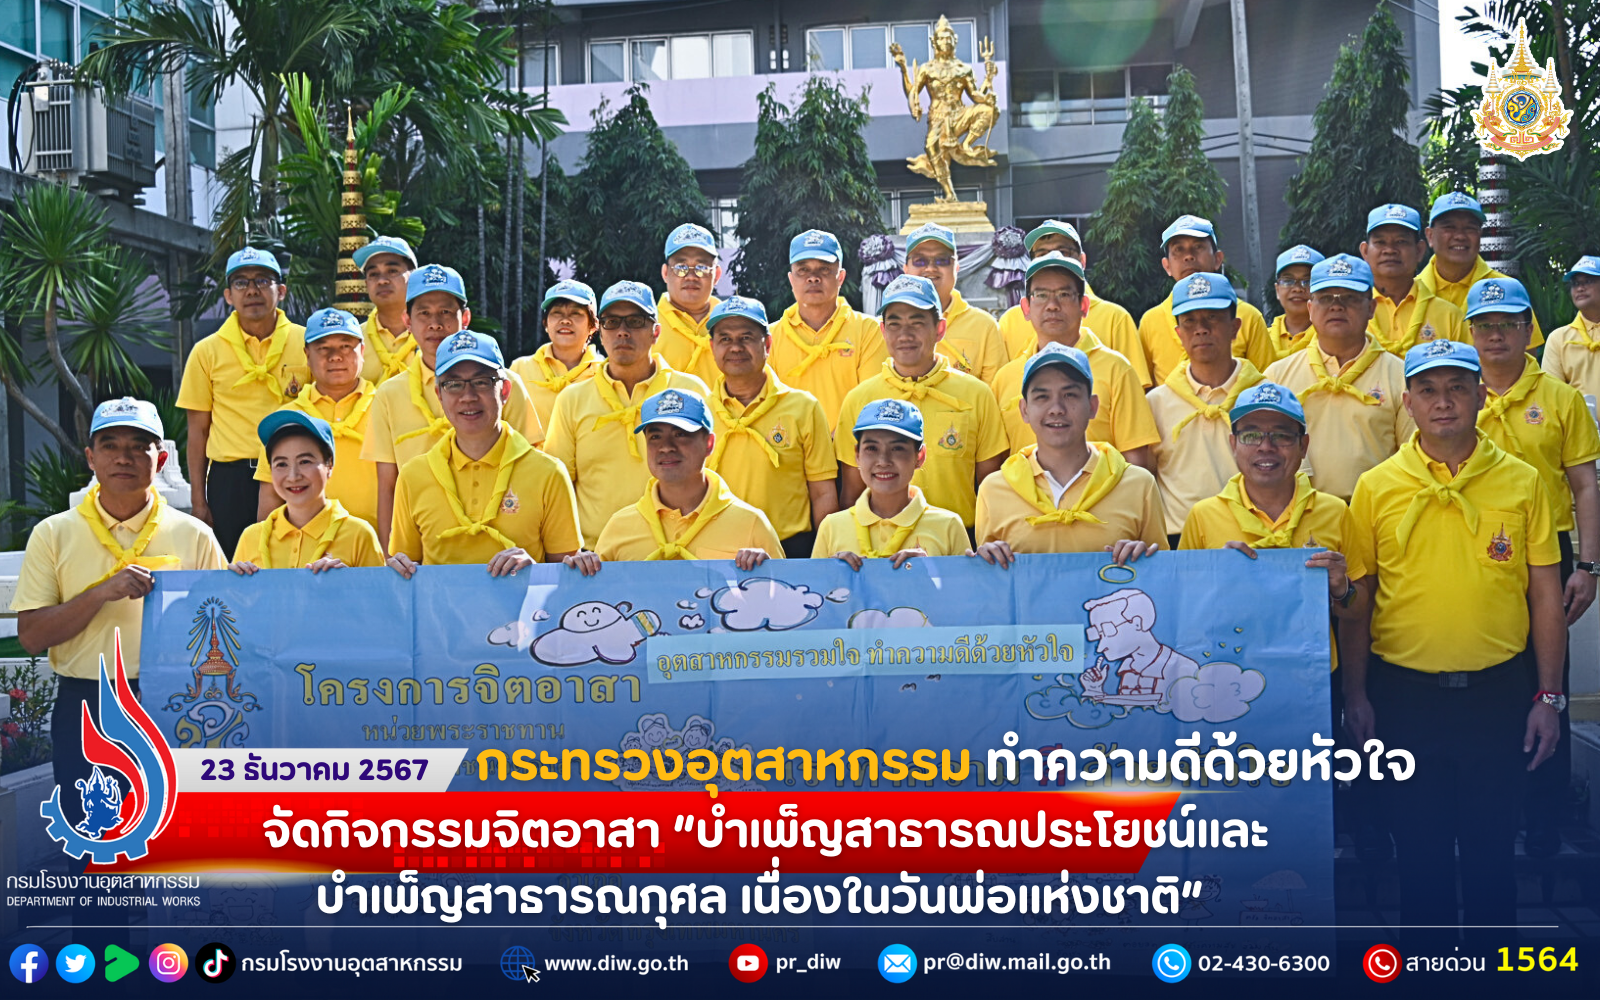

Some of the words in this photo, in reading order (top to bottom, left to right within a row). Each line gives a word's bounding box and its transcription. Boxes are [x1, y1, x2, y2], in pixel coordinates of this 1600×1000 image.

[656, 638, 860, 679] อุตสาหกรรมรวมใจ
[866, 632, 1075, 666] ทำความดีด้วยหัวใจ
[294, 662, 642, 706] โครงการจิตอาสา
[361, 715, 566, 742] หน่วยพระราชทาน
